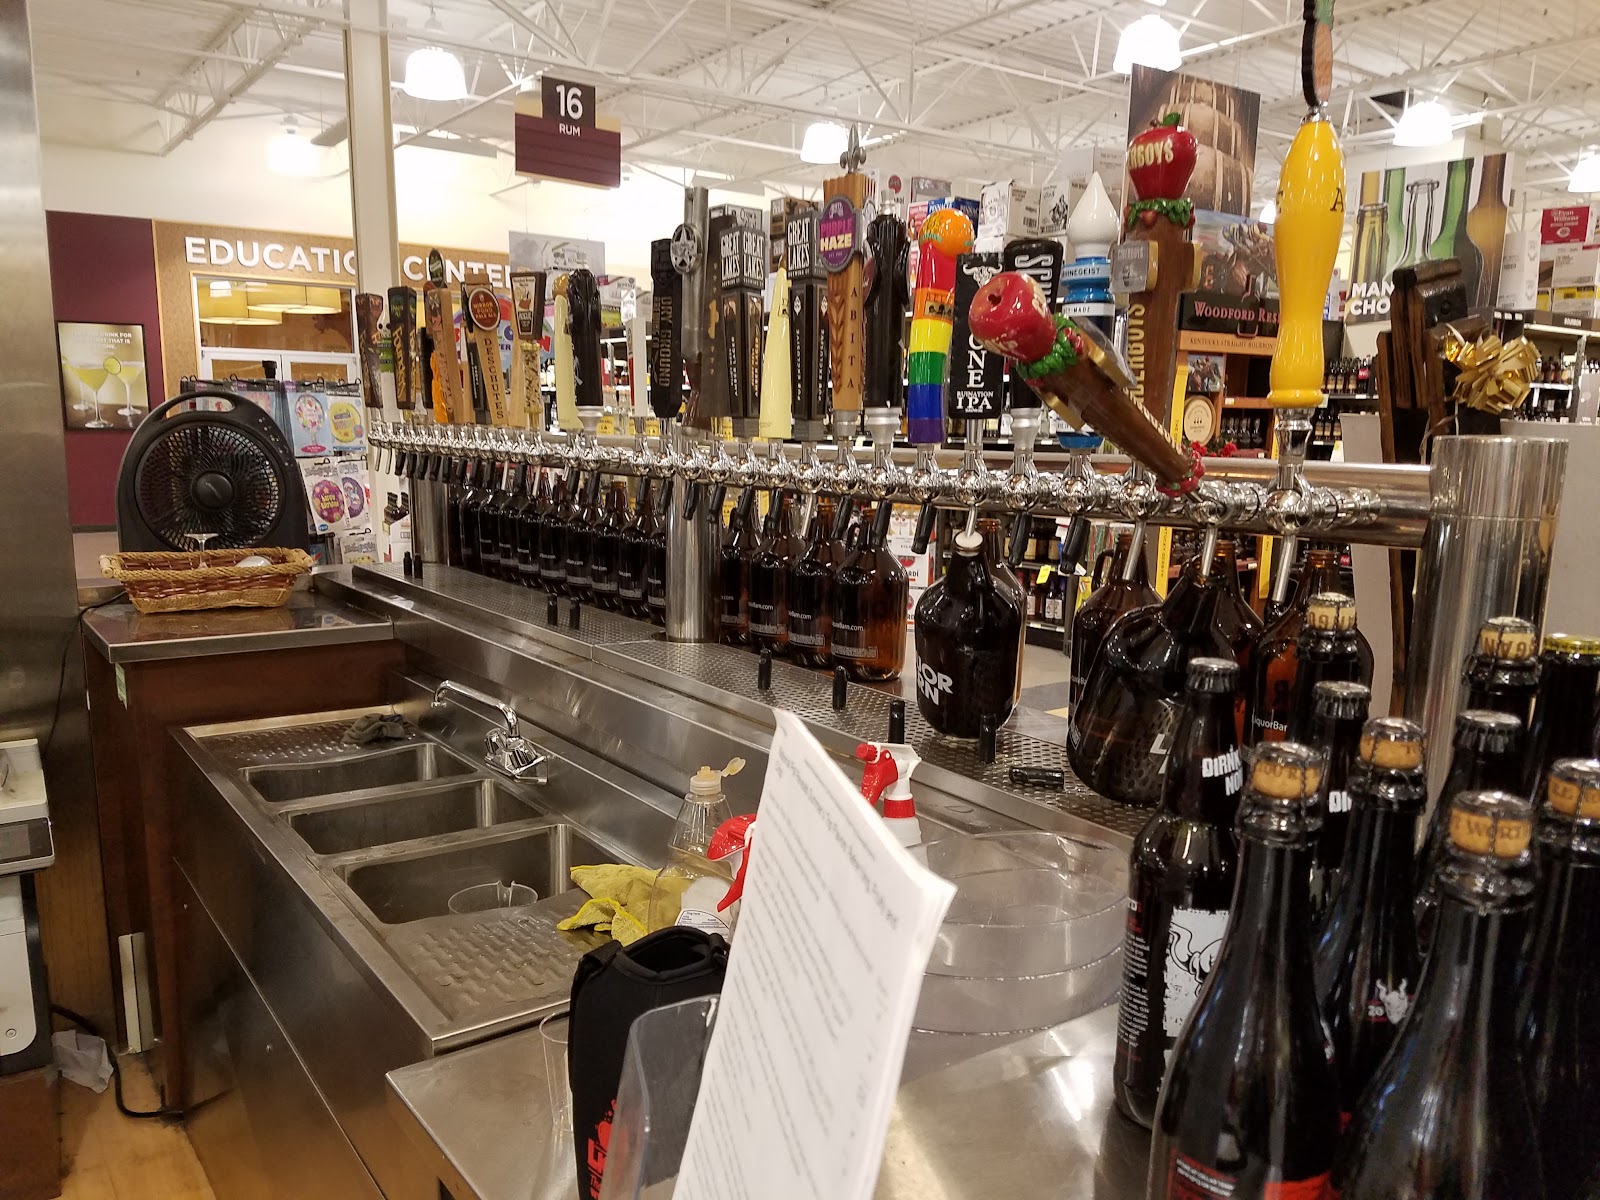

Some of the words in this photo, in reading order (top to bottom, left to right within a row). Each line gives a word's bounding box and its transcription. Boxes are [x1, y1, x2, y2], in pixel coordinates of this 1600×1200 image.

[556, 84, 583, 120] 16
[559, 123, 581, 136] RUM
[788, 217, 810, 246] GREAT
[821, 218, 853, 237] PURPLE
[721, 231, 740, 259] GREAT
[744, 231, 764, 259] GREAT
[820, 232, 852, 252] HAZE
[721, 254, 740, 281] LAKES
[744, 253, 764, 280] LAKES
[788, 243, 810, 270] LAKES
[1351, 281, 1395, 298] MAN
[660, 297, 673, 325] DRY
[1194, 301, 1255, 321] WOODFORD
[1350, 297, 1391, 316] CHO
[847, 286, 858, 389] ABITA
[659, 330, 672, 387] GROUND
[484, 338, 504, 419] DESCHUTES
[956, 391, 994, 400] RUINATION
[956, 397, 992, 410] IPA
[1252, 712, 1288, 732] LiquorBar
